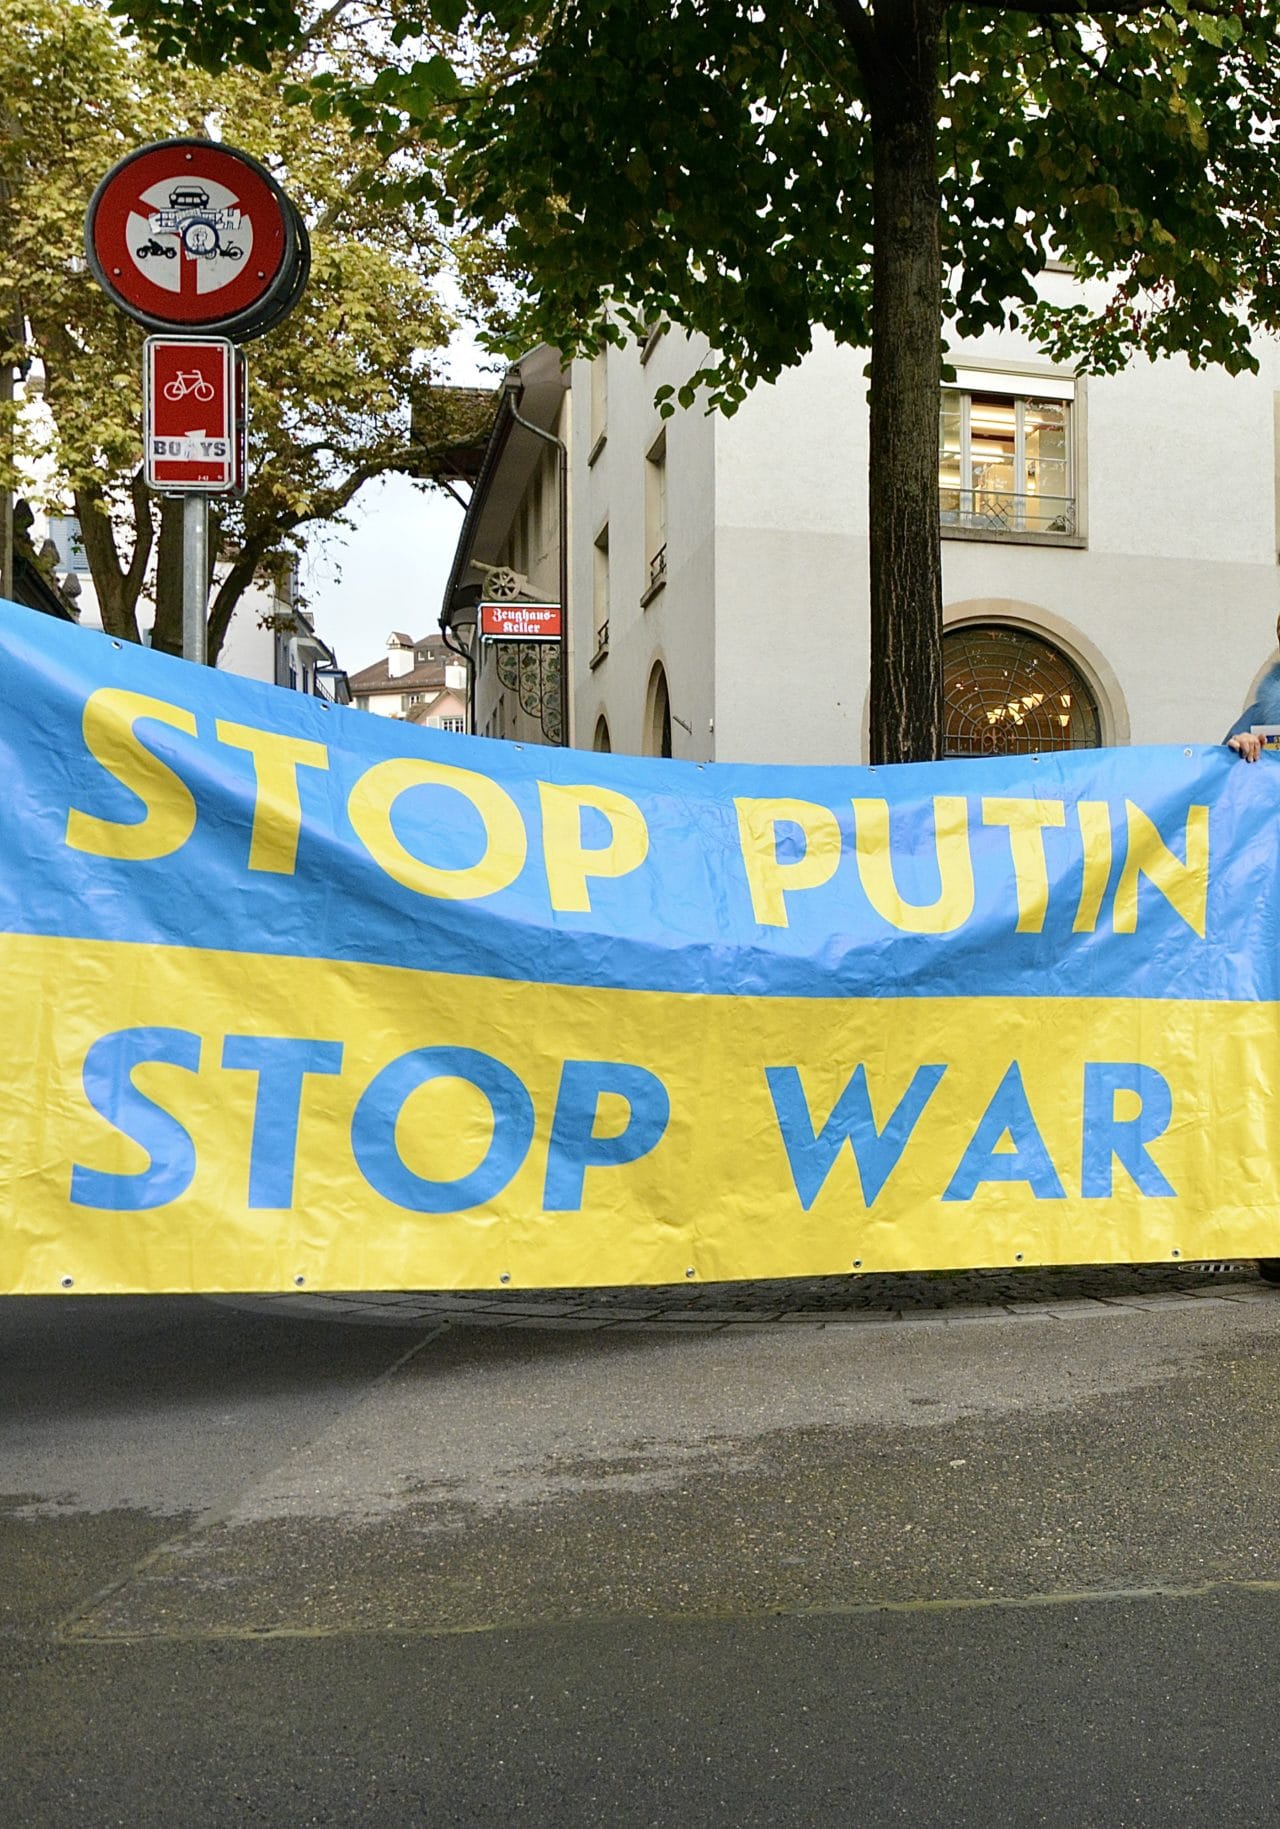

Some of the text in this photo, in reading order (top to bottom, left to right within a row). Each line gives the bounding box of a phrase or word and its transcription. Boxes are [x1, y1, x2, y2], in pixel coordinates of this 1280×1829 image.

[492, 608, 557, 622] Zeughaus-
[503, 621, 541, 633] Keller
[65, 687, 1210, 939] STOP PUTIN
[69, 1026, 1178, 1215] STOP WAR
